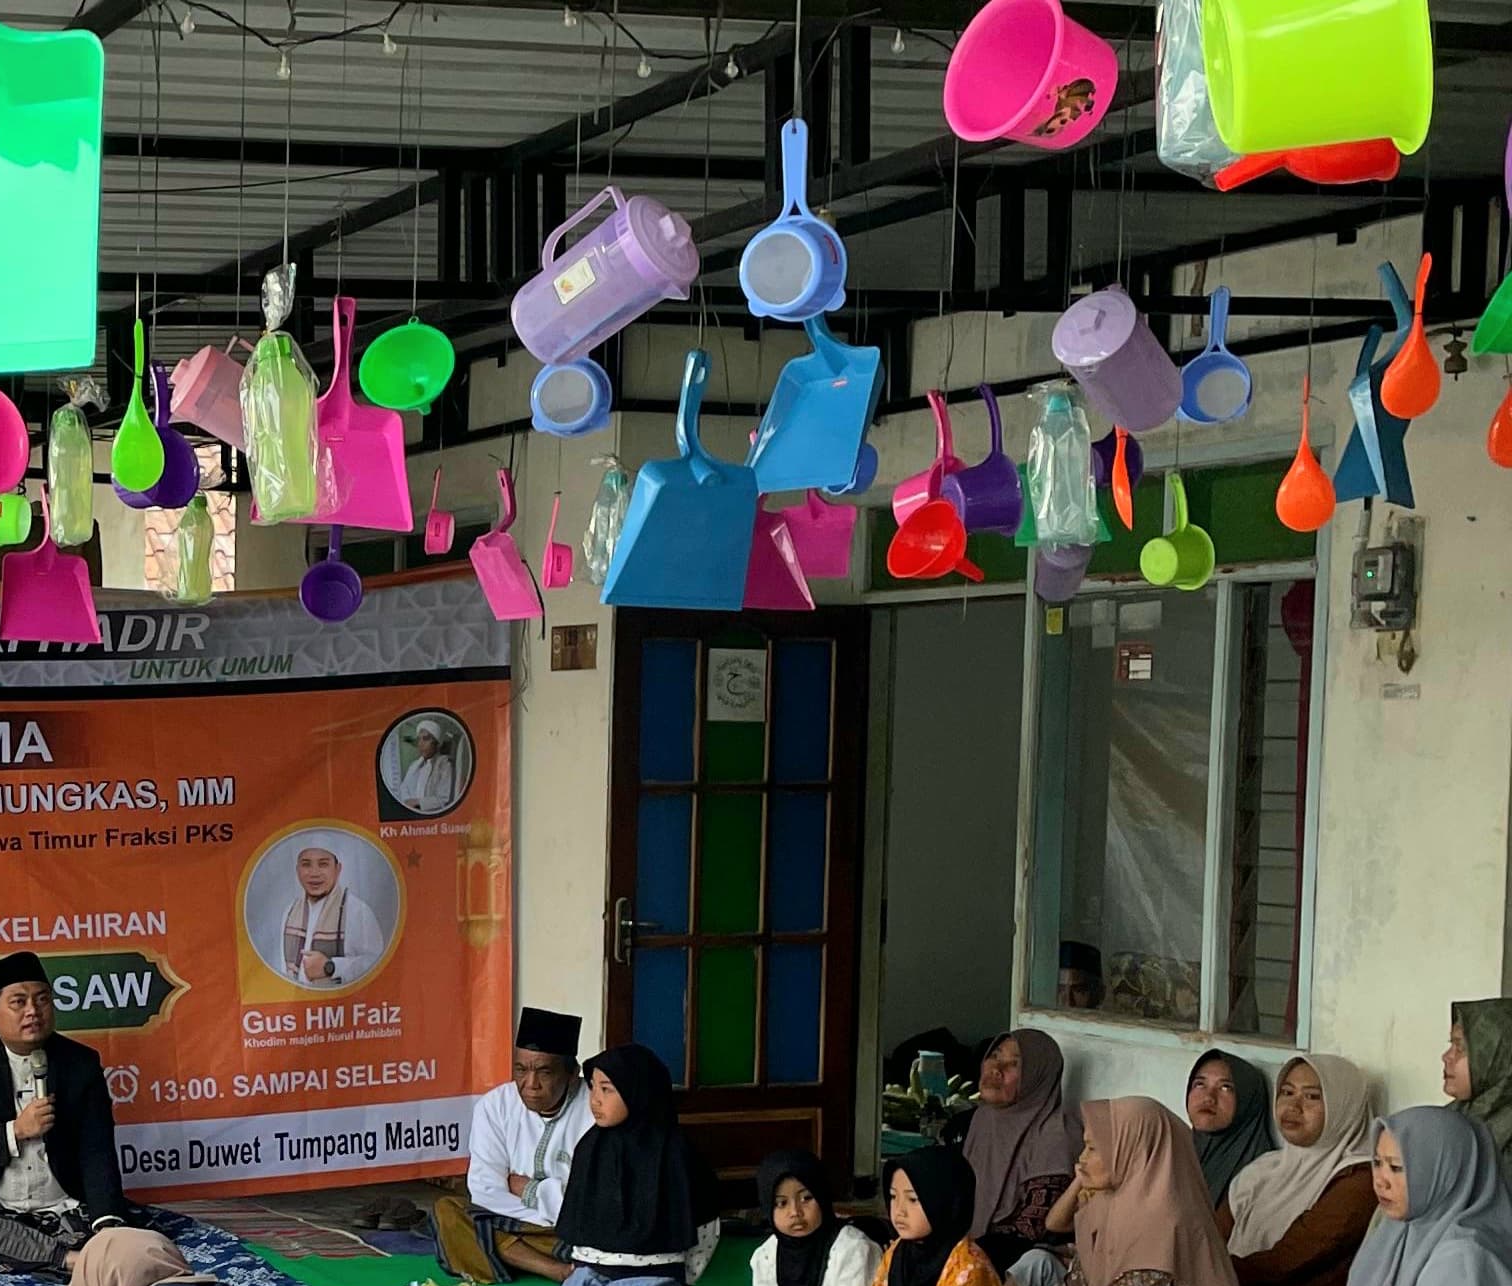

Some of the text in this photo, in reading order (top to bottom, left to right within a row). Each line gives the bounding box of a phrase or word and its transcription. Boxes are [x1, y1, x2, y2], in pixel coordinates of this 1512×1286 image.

[129, 654, 294, 680] UNTUK UMUM
[178, 777, 235, 807] MM
[29, 829, 97, 851] Timur
[105, 825, 178, 849] Fraksi
[185, 823, 234, 844] PKS
[400, 824, 438, 836] Ahmad
[53, 971, 152, 1011] SAW
[242, 1001, 401, 1034] Gus HM Faiz
[243, 1038, 286, 1048] Khodim
[150, 1059, 437, 1102] 13:00. SAMPAI SELESAI
[120, 1144, 180, 1174] Desa
[189, 1136, 261, 1168] Duwet
[275, 1131, 377, 1164] Tumpang
[385, 1119, 459, 1151] Malang
